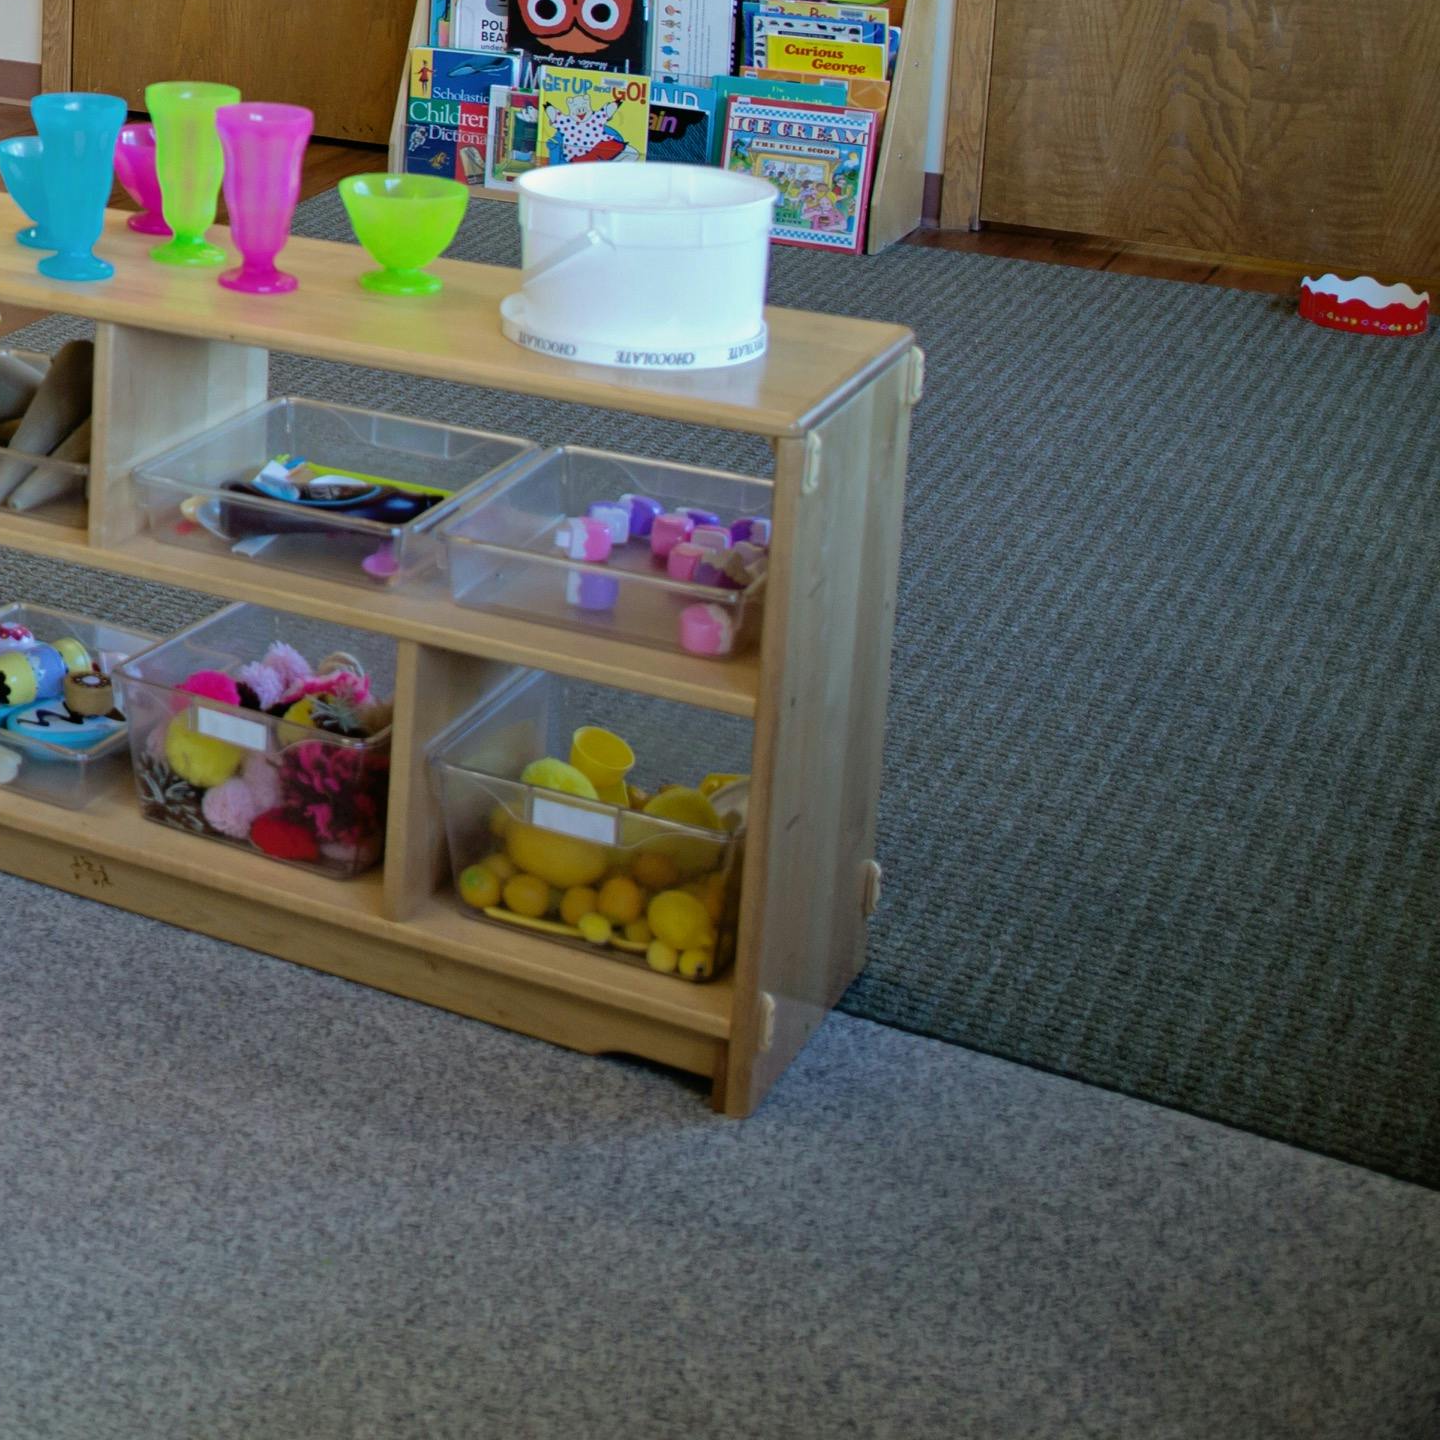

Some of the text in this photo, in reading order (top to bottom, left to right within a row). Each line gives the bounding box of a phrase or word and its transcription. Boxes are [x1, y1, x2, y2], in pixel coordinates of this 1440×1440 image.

[481, 19, 508, 31] POL
[481, 31, 508, 42] BEA
[481, 44, 507, 52] under
[784, 43, 844, 60] Curious
[812, 59, 866, 76] George
[432, 86, 490, 104] Scholastic
[542, 73, 570, 92] GET
[571, 76, 593, 95] UP
[593, 83, 612, 94] and
[612, 80, 648, 105] GO!
[409, 101, 489, 128] Childre
[649, 110, 678, 134] ain
[428, 124, 486, 146] Dictiona
[729, 115, 868, 146] ICE CREAM
[755, 140, 838, 156] THE FULL SCOOP
[615, 350, 696, 365] CHOCOLATE
